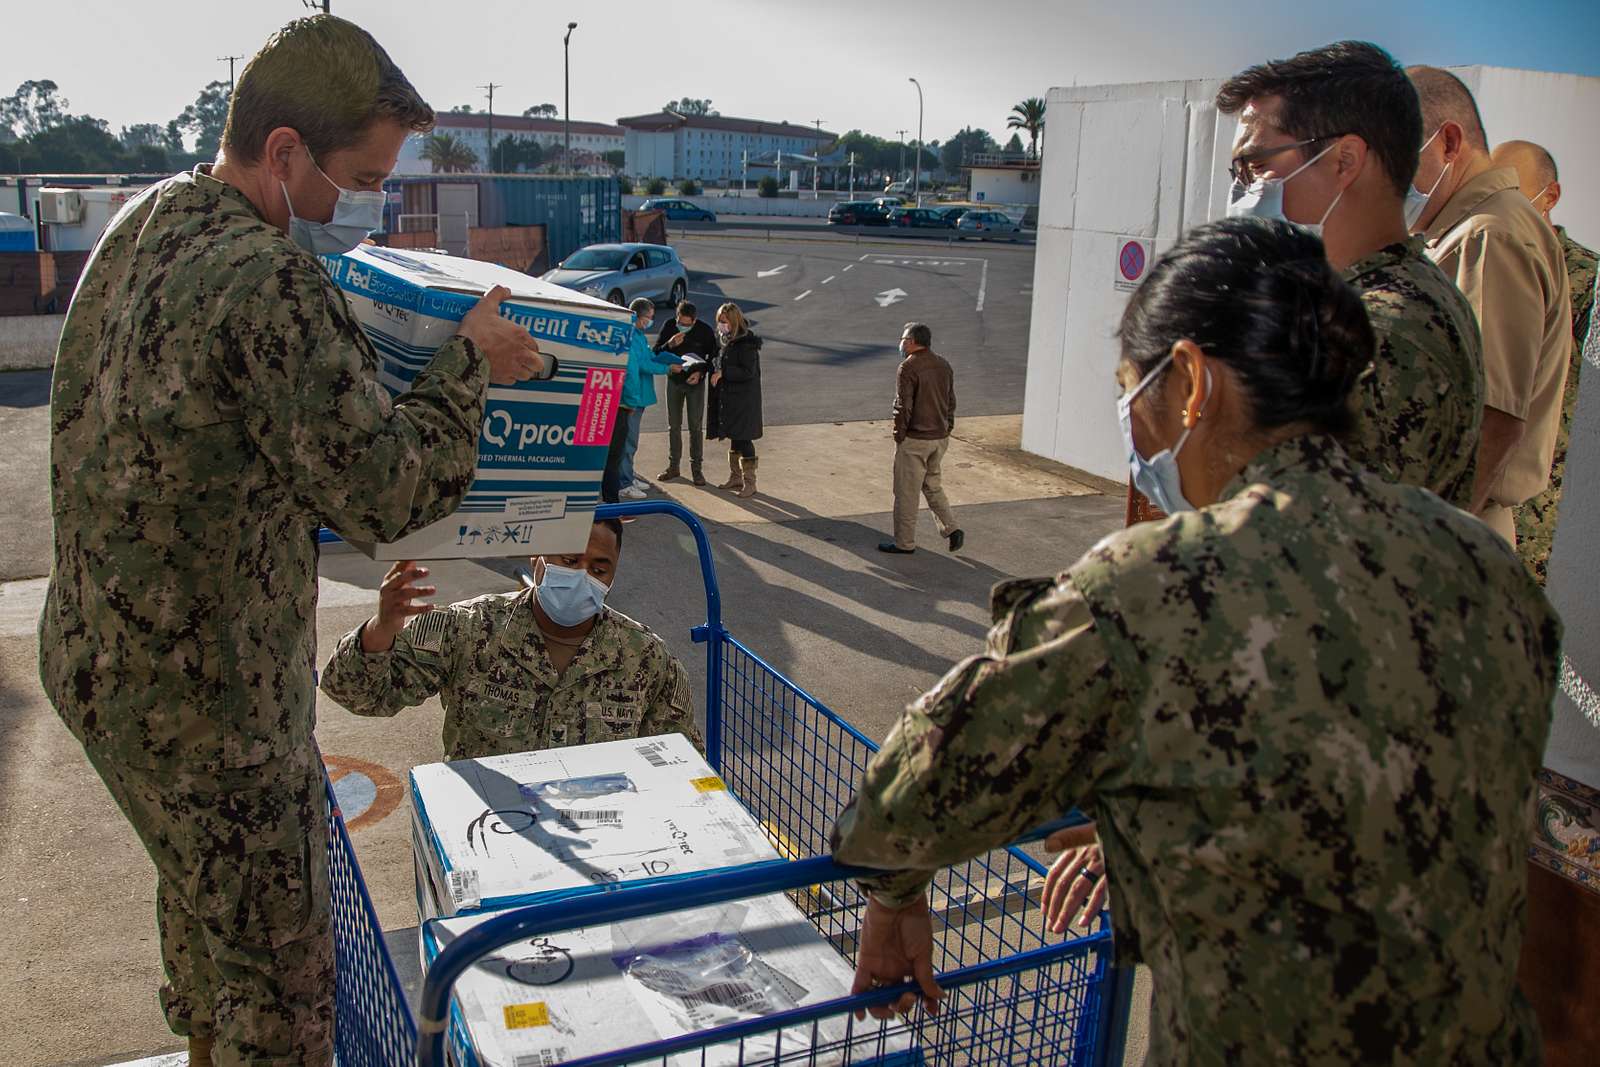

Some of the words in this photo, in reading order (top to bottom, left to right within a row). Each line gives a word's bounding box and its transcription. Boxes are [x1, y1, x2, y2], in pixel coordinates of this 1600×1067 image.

[589, 370, 613, 390] PA
[587, 392, 604, 443] BOARDING
[598, 393, 612, 437] PRIORITY
[477, 454, 493, 462] FIED
[494, 454, 526, 463] THERMAL
[527, 455, 566, 464] PACKAGING
[483, 683, 520, 703] THOMAS
[601, 705, 614, 718] U.S.
[616, 708, 634, 719] NAVY
